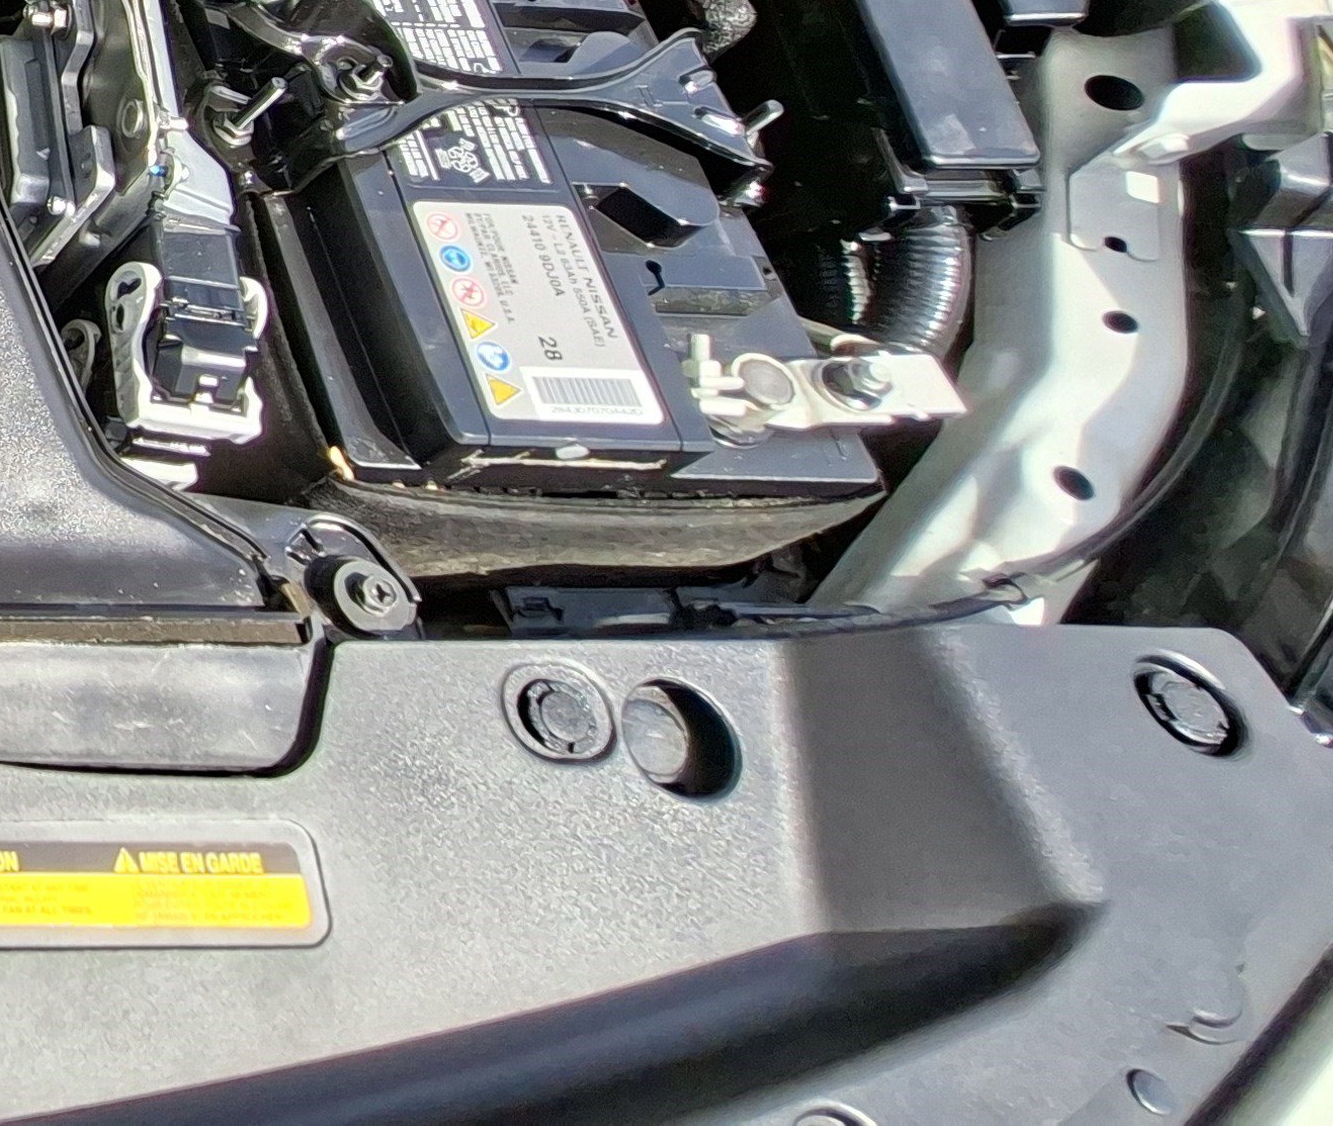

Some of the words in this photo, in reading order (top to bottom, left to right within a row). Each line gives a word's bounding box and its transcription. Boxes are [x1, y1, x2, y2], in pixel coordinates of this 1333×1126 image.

[522, 215, 546, 250] 24410
[541, 215, 555, 231] 12V
[583, 317, 605, 346] (SAE)
[555, 215, 589, 273] RENAULT
[583, 277, 617, 338] NISSAN
[537, 336, 564, 361] 28
[138, 851, 180, 873] MISE
[180, 851, 205, 874] EN
[205, 851, 265, 874] GARDE
